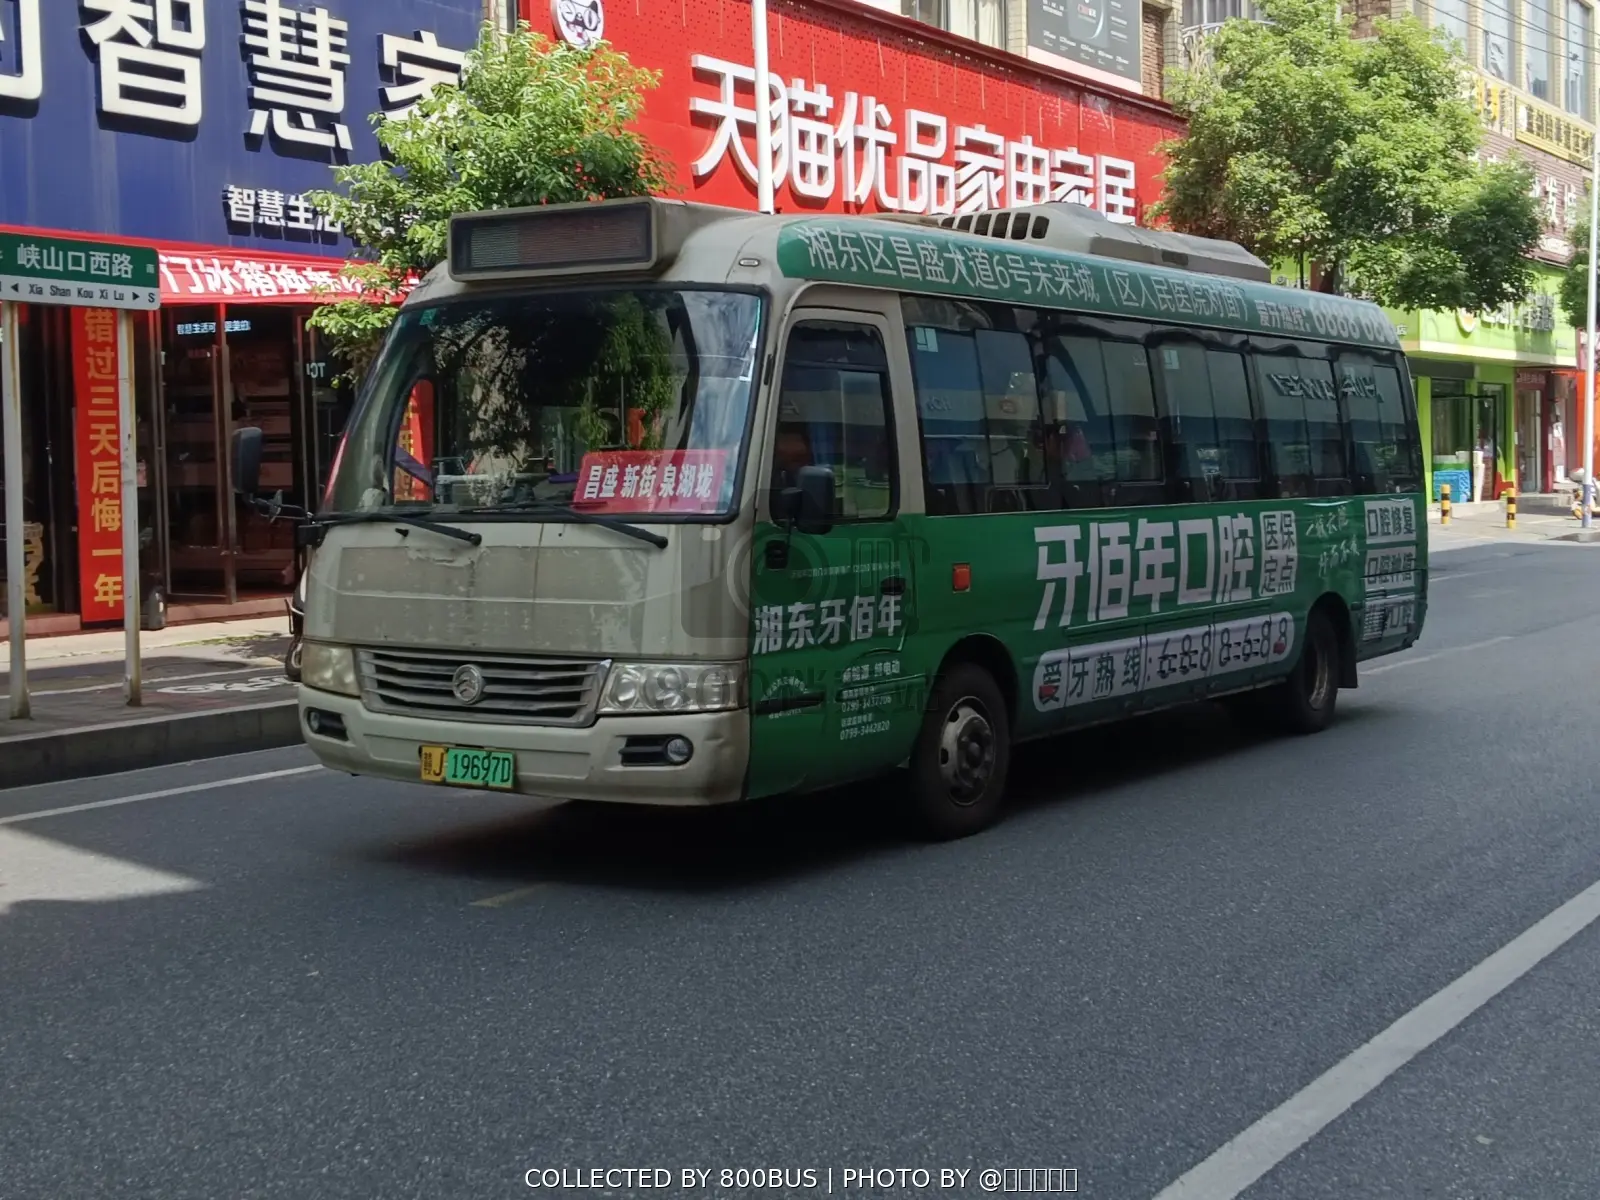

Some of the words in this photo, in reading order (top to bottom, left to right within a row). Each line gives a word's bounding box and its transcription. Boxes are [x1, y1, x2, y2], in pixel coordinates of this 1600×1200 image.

[688, 53, 1135, 225] 天猫优品家电家居
[17, 243, 133, 279] 峡山口西路
[28, 283, 44, 296] Xia
[49, 284, 72, 298] Shan
[77, 286, 94, 300] Kou
[99, 288, 109, 301] Xi
[114, 289, 125, 302] Lu
[147, 291, 156, 304] S
[84, 307, 124, 608] 错过三天后悔一年
[1262, 513, 1295, 551] 医保
[1033, 512, 1255, 631] 牙佰年口腔
[1262, 555, 1295, 593] 定点
[753, 595, 902, 654] 湘东牙佰年
